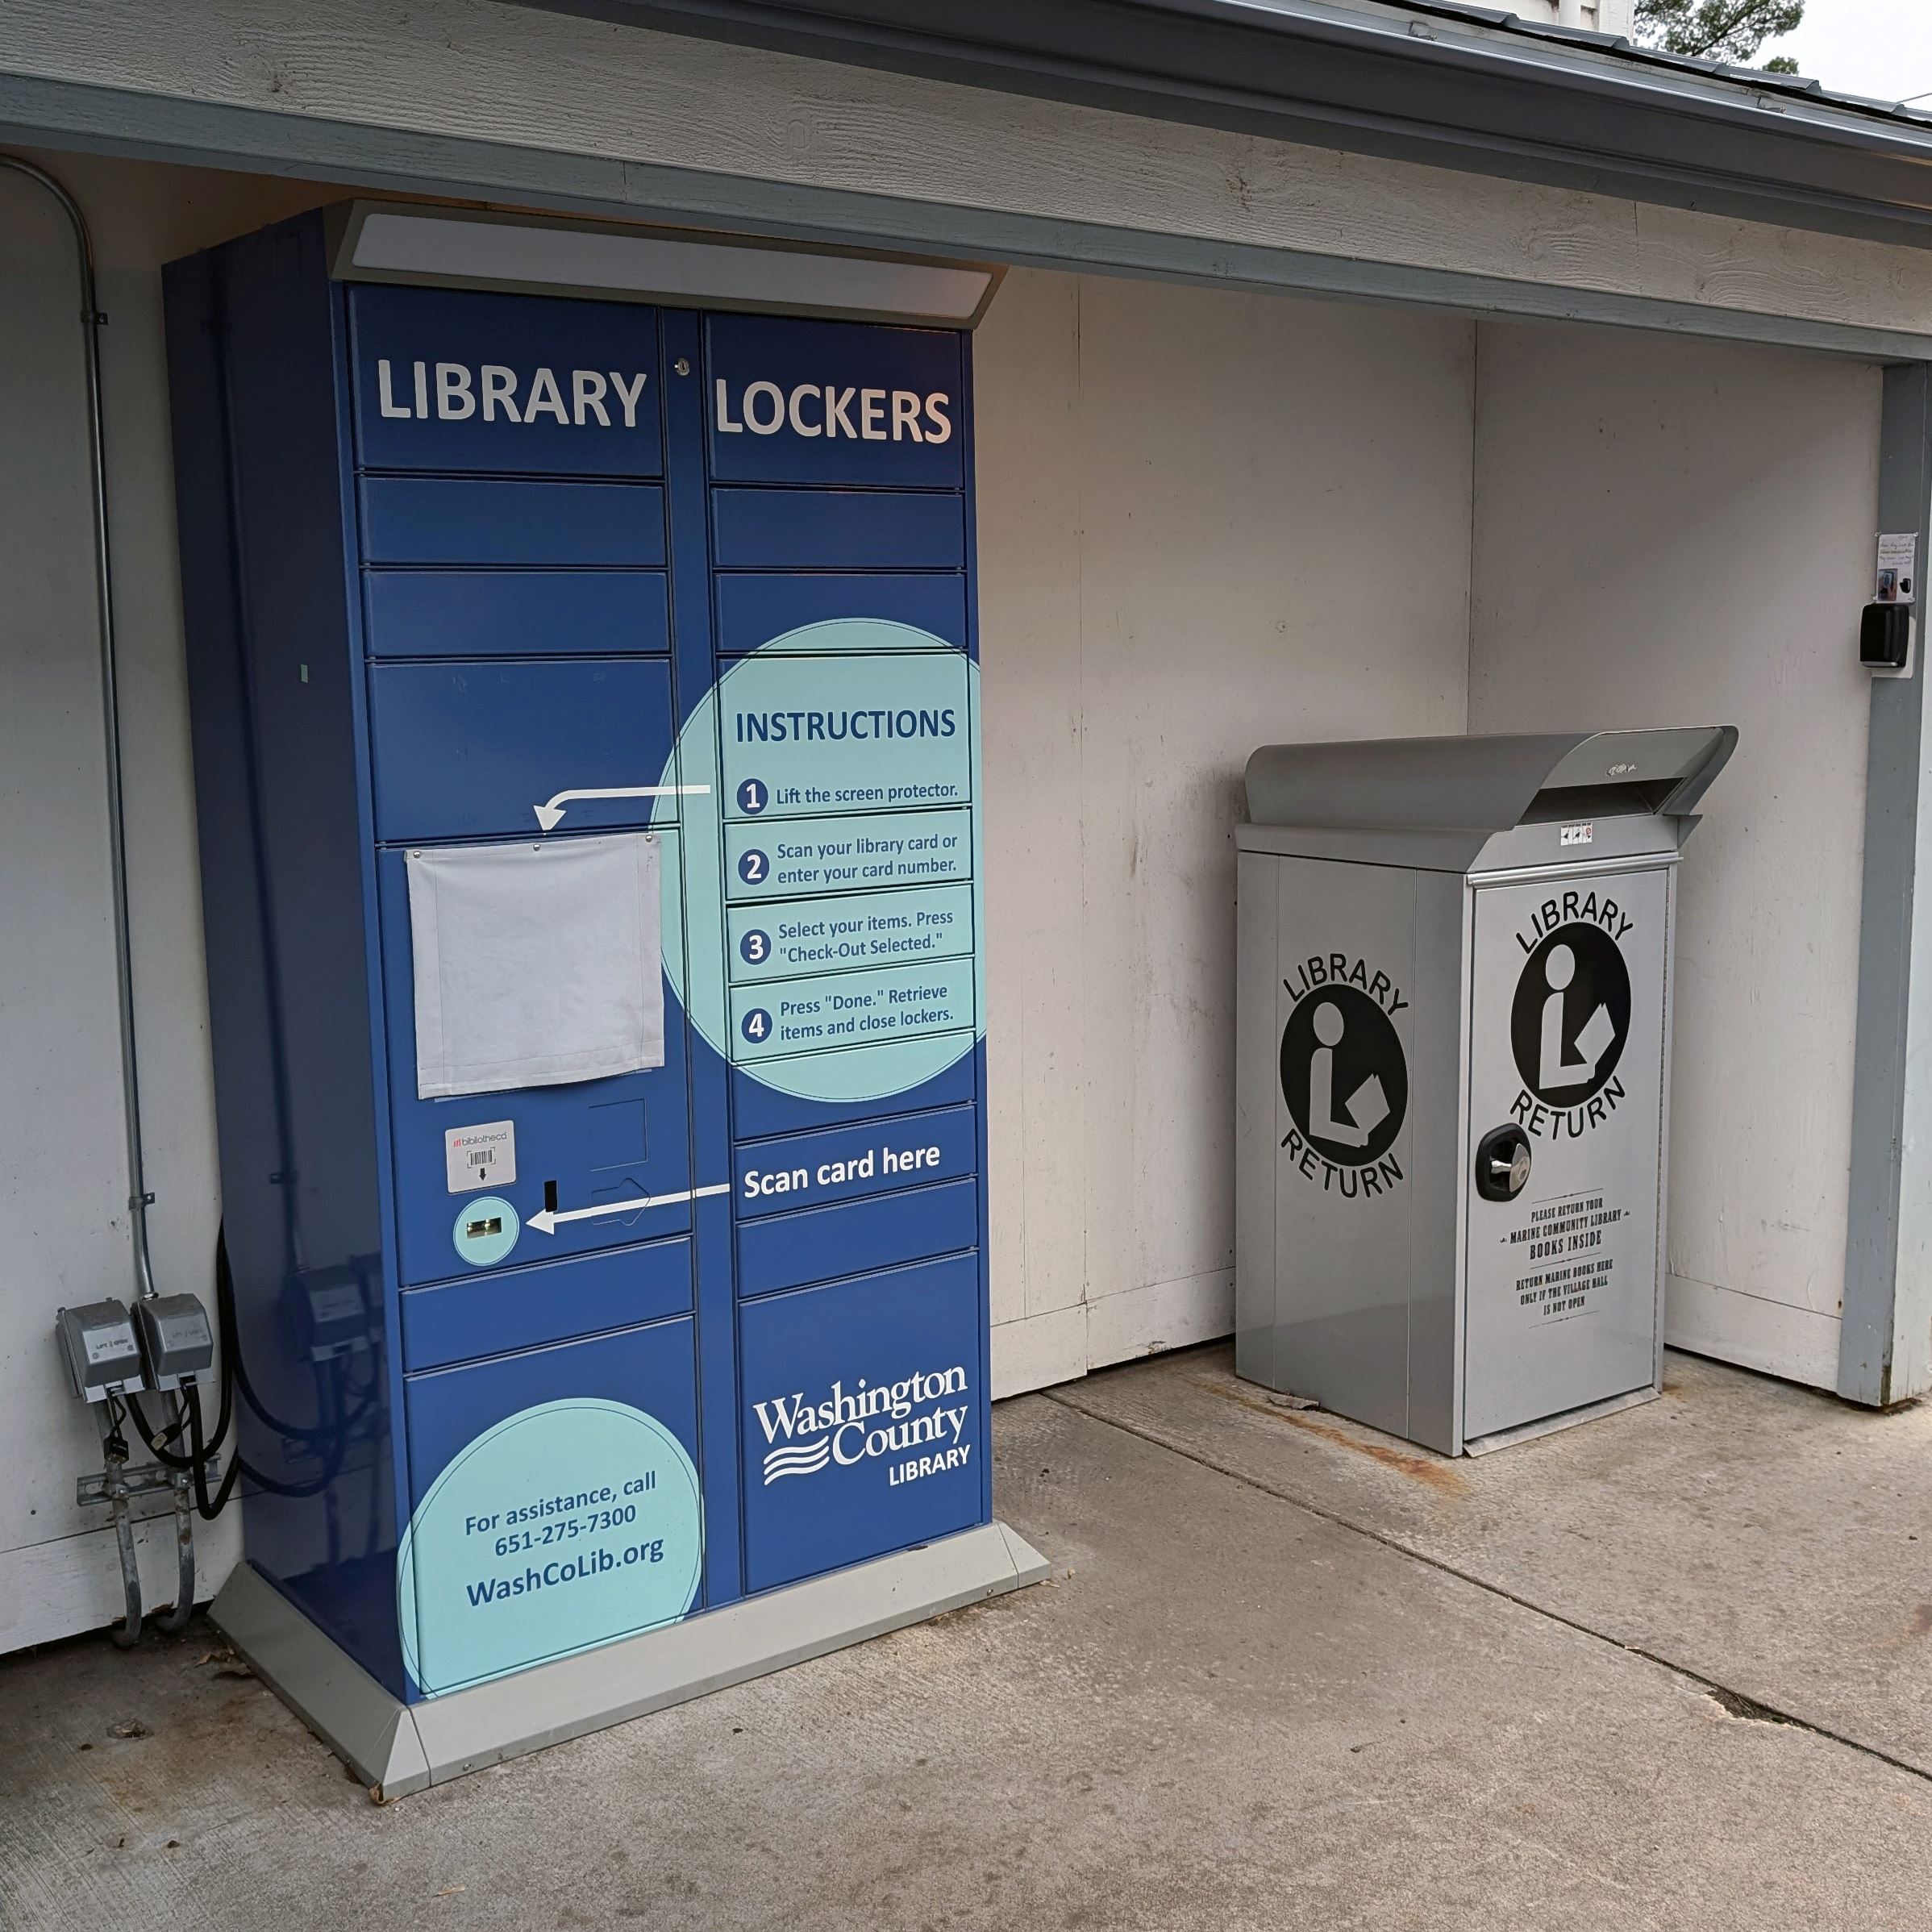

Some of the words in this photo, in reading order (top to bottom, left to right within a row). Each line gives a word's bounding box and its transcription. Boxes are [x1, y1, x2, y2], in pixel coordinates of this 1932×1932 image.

[377, 359, 647, 427] LIBRARY
[715, 378, 951, 444] LOCKERS
[736, 709, 956, 743] INSTRUCTIONS
[746, 784, 760, 808] 1
[777, 788, 801, 805] Lift
[805, 787, 831, 803] the
[835, 789, 884, 802] screen
[888, 784, 958, 803] protector.
[777, 843, 813, 859] Scan
[818, 843, 851, 860] your
[856, 837, 904, 855] library
[907, 835, 939, 851] card
[943, 836, 957, 848] or
[747, 855, 762, 879] 2
[777, 869, 818, 883] enter
[823, 868, 857, 884] your
[862, 860, 893, 877] card
[897, 858, 956, 875] number.
[778, 922, 825, 939] Select
[829, 920, 863, 938] your
[867, 914, 912, 931] items.
[916, 910, 953, 926] Press
[1516, 891, 1634, 955] LIBRARY
[748, 935, 764, 960] 3
[780, 941, 866, 964] "Check-Out
[870, 933, 943, 953] Selected."
[1283, 953, 1409, 1016] LIBRARY
[781, 1000, 820, 1017] Press
[825, 990, 884, 1010] "Done."
[889, 985, 947, 1004] Retrieve
[748, 1014, 764, 1038] 4
[781, 1023, 822, 1041] items
[827, 1018, 855, 1035] and
[860, 1013, 896, 1031] close
[900, 1006, 954, 1026] lockers.
[1509, 1076, 1626, 1140] RETURN
[462, 1132, 507, 1146] bibliotheca
[744, 1168, 808, 1198] Scan
[817, 1150, 874, 1185] card
[883, 1146, 940, 1174] here
[1280, 1128, 1403, 1198] RETURN
[1531, 1208, 1555, 1222] PLEASE
[1558, 1201, 1584, 1217] RETURN
[1586, 1197, 1603, 1210] YOUR
[1510, 1226, 1540, 1244] MARINE
[1543, 1216, 1588, 1237] COMMUNITY
[1591, 1210, 1622, 1227] LIBRARY
[1530, 1239, 1564, 1260] BOOKS
[1568, 1230, 1601, 1251] INSIDE
[1516, 1275, 1543, 1291] RETURN
[1545, 1268, 1571, 1285] MARINE
[1573, 1264, 1594, 1277] BOOKS
[1597, 1259, 1613, 1272] HERE
[1521, 1292, 1537, 1305] ONLY
[1539, 1290, 1547, 1301] IF
[1548, 1286, 1561, 1299] THE
[1563, 1280, 1590, 1296] VILLAGE
[1592, 1276, 1608, 1288] HALL
[1543, 1305, 1551, 1316] IS
[1553, 1300, 1566, 1314] NOT
[1568, 1296, 1585, 1309] OPEN
[752, 1366, 968, 1444] Washington
[832, 1405, 968, 1465] County
[889, 1444, 971, 1486] LIBRARY
[465, 1514, 500, 1535] For
[506, 1487, 617, 1525] assistance,
[623, 1470, 656, 1496] call
[495, 1505, 636, 1556] 651-275-7300
[466, 1539, 664, 1607] WashCoLib.org
